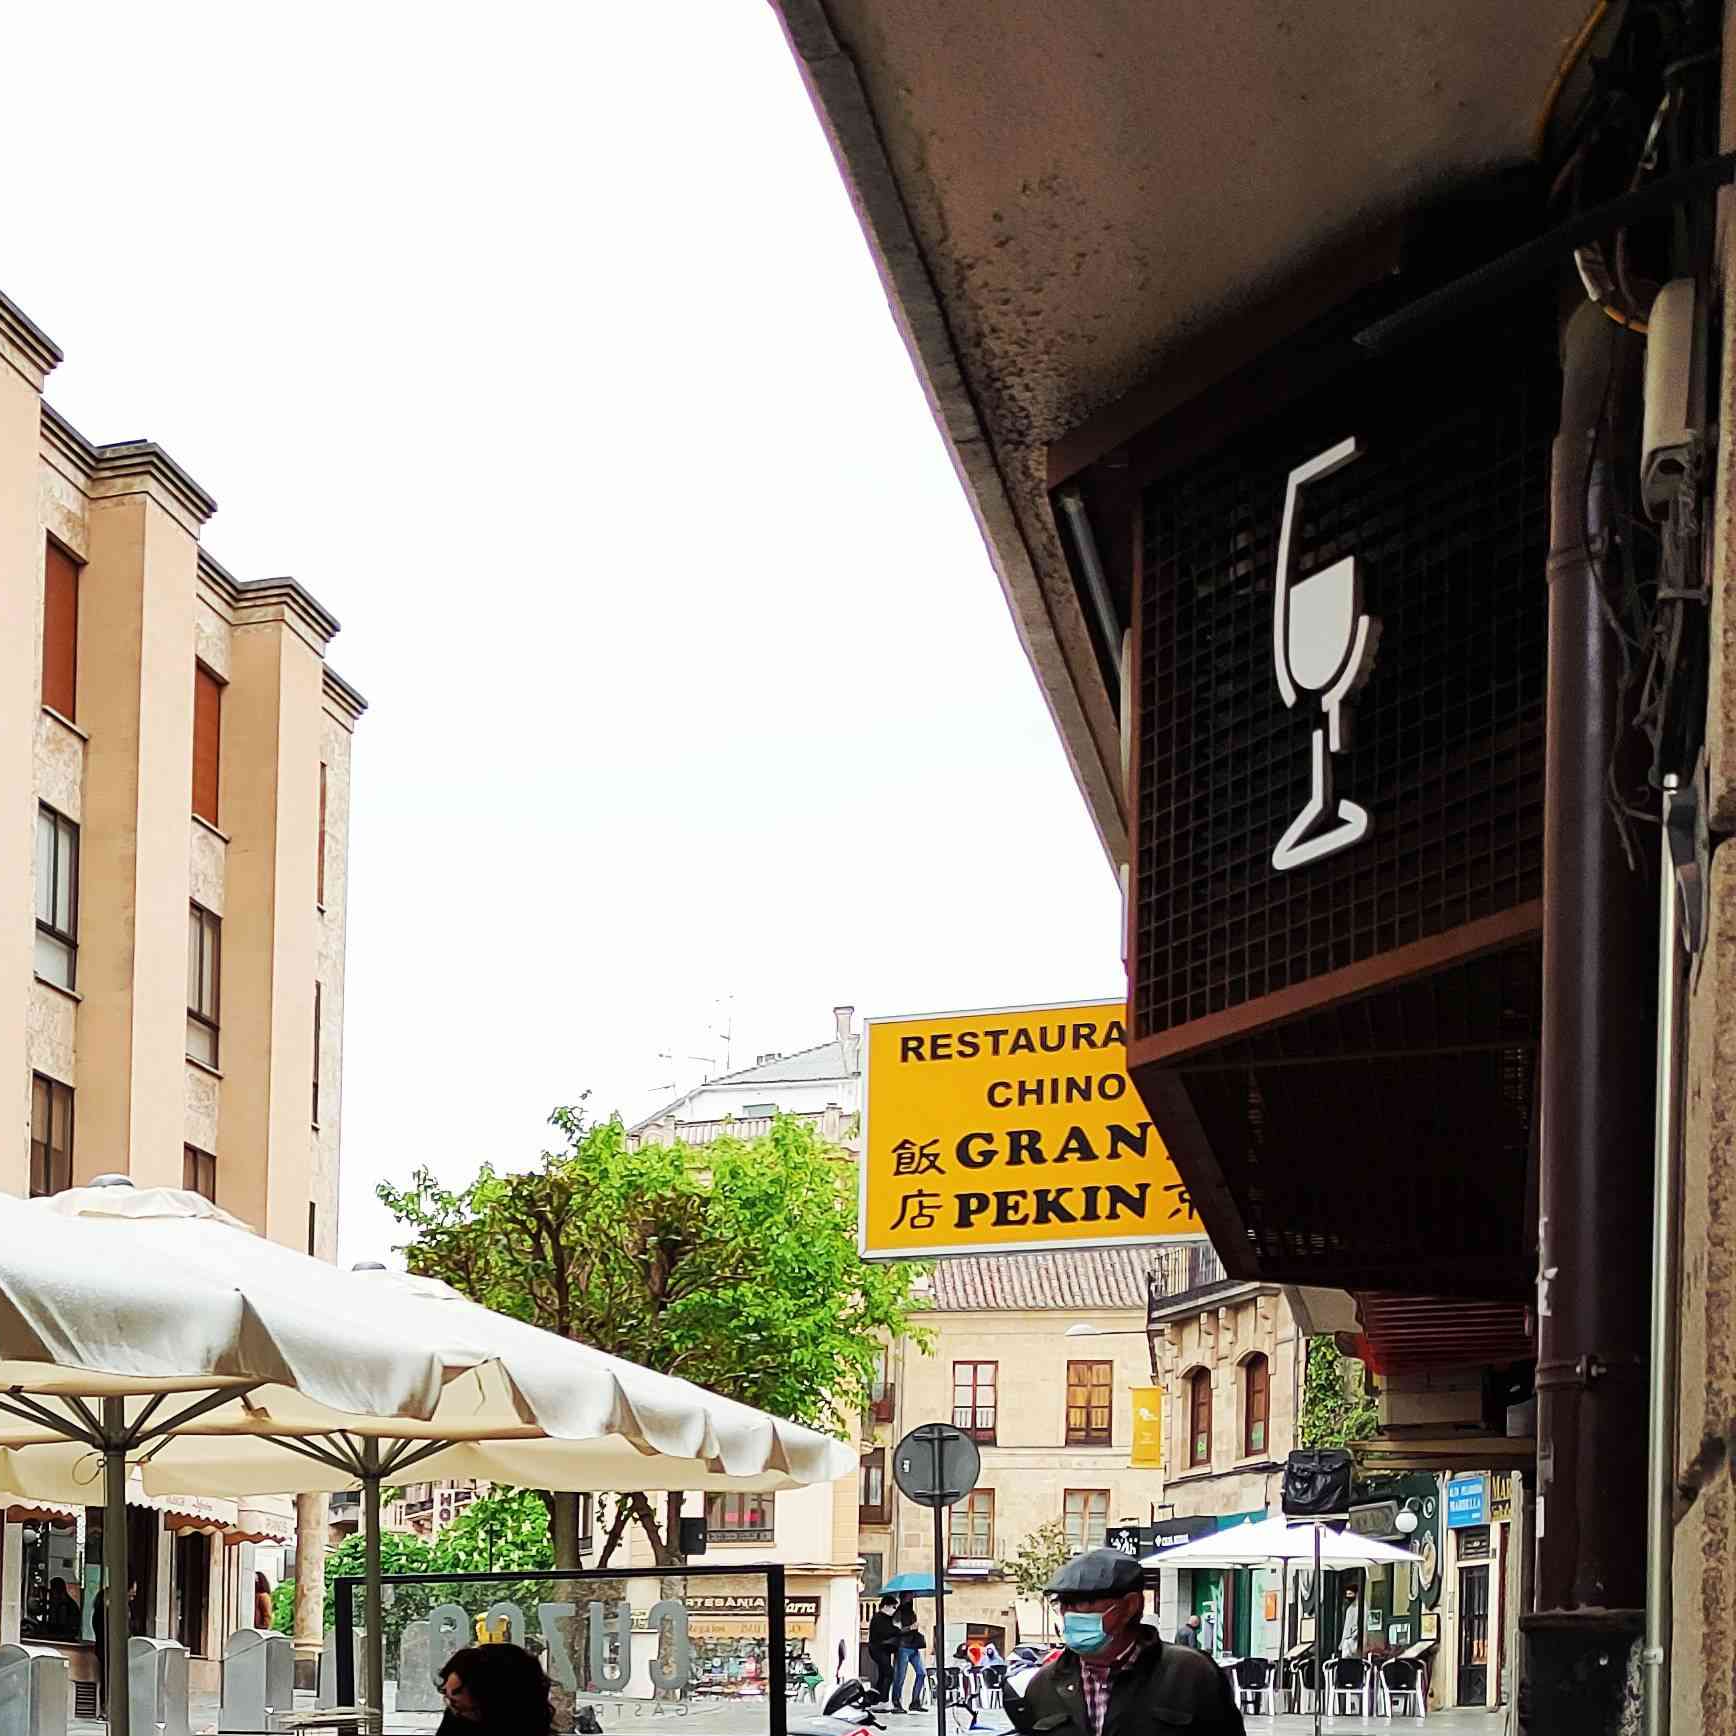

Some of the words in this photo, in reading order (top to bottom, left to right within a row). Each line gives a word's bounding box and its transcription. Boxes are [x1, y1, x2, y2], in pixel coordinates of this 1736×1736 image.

[986, 1073, 1127, 1108] CHINO
[891, 1137, 947, 1177] 飯
[955, 1121, 1154, 1170] GRAN
[888, 1188, 944, 1231] 店
[952, 1182, 1152, 1231] PEKIN
